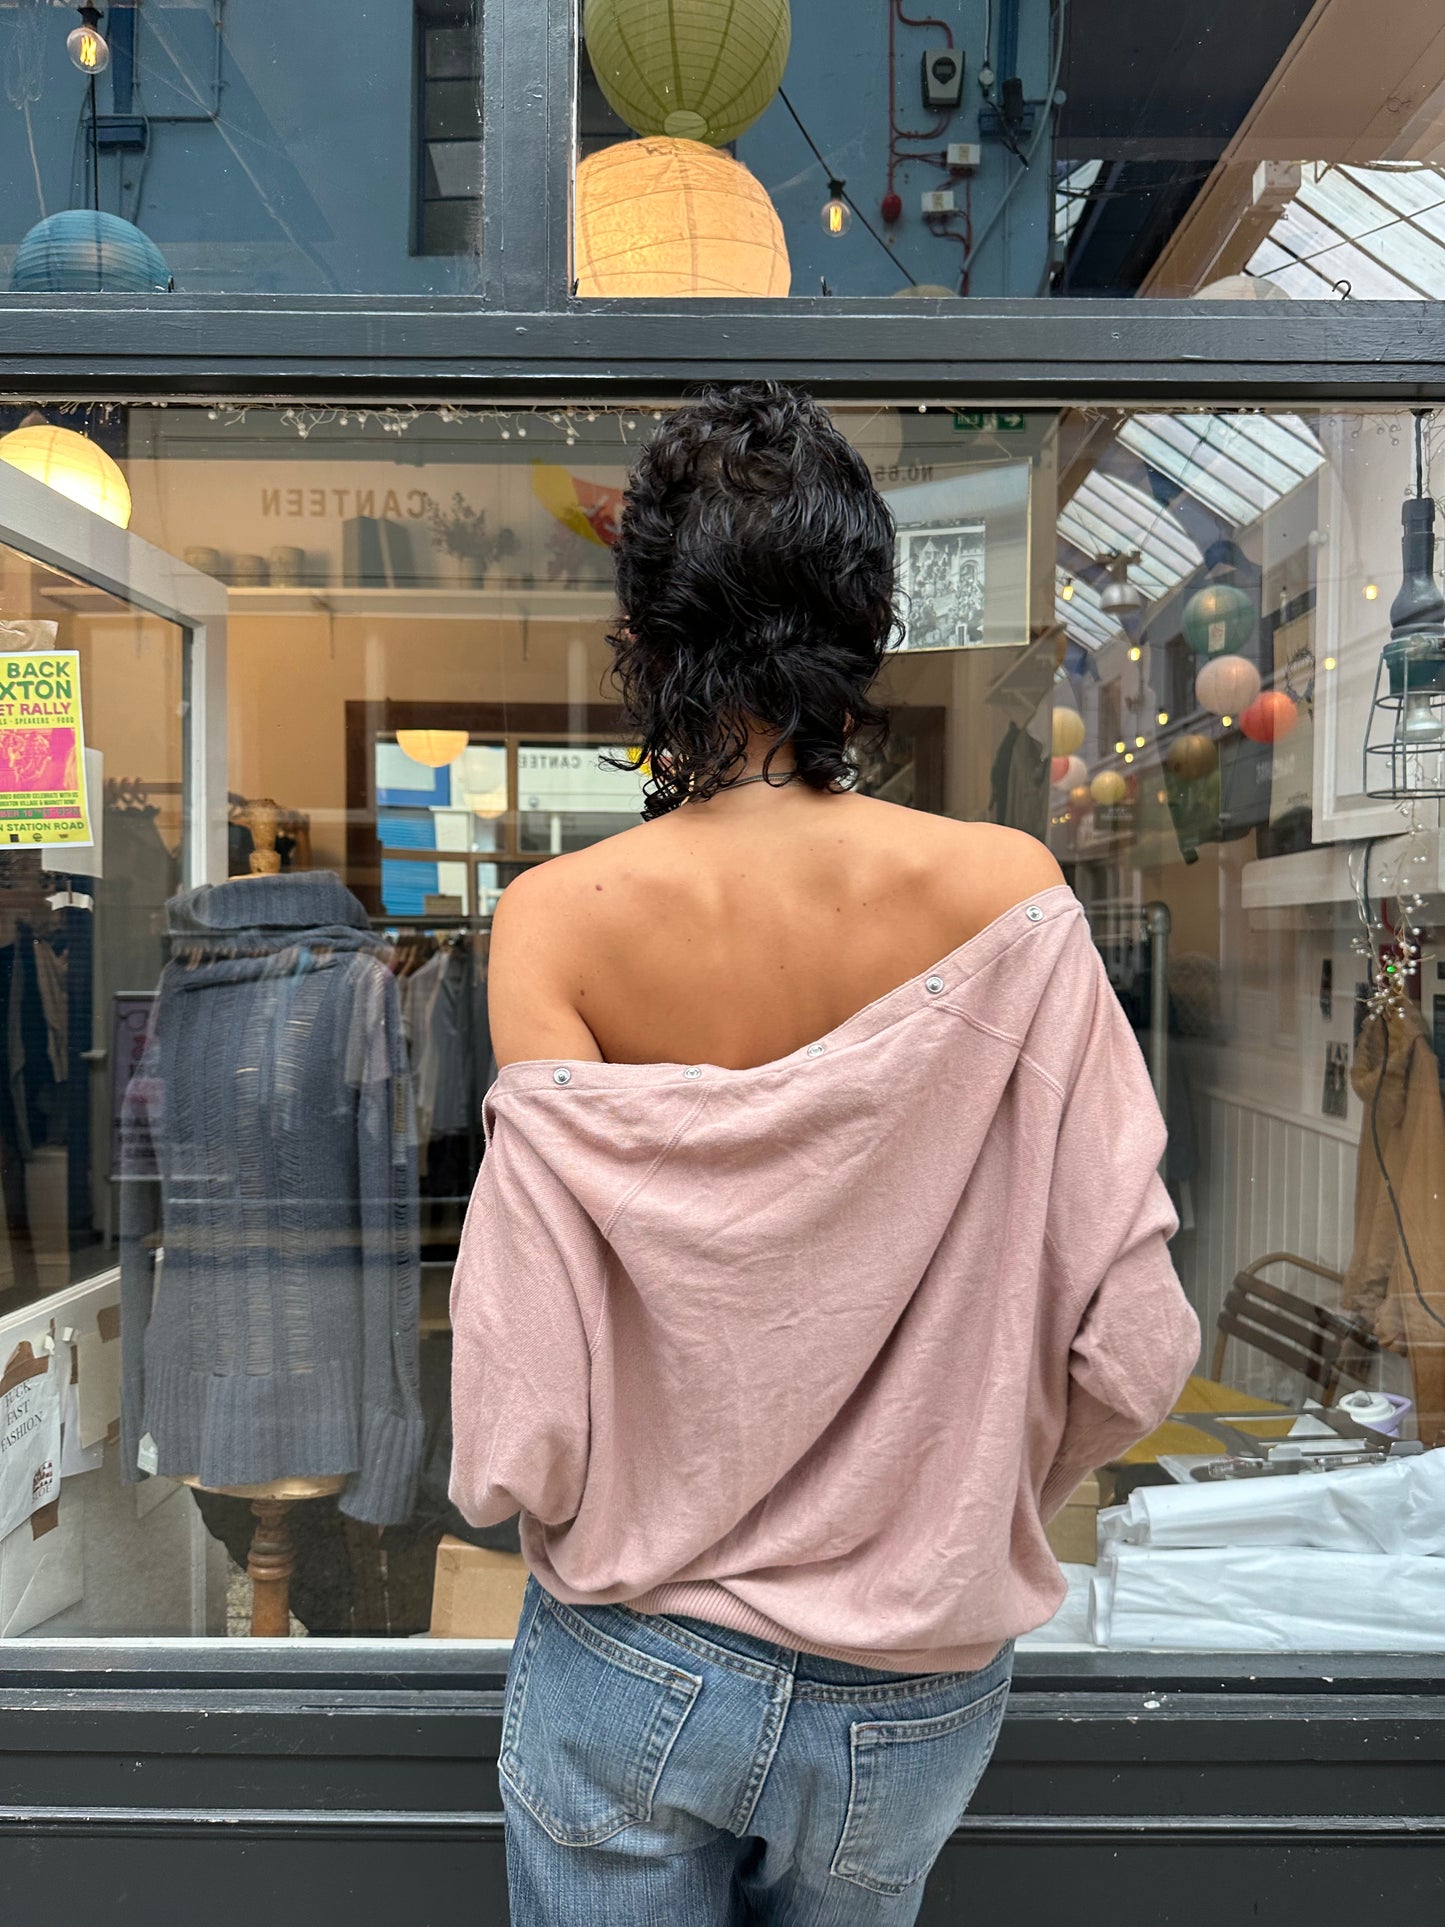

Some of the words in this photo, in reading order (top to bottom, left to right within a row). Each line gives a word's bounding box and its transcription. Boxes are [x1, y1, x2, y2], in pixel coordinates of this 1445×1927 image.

[7, 661, 70, 678] BACK
[0, 679, 72, 700] XTON
[20, 702, 71, 715] RALLY
[7, 823, 51, 831] STATION
[54, 822, 84, 830] ROAD
[6, 1400, 31, 1426] FAST
[0, 1410, 44, 1453] FASHION
